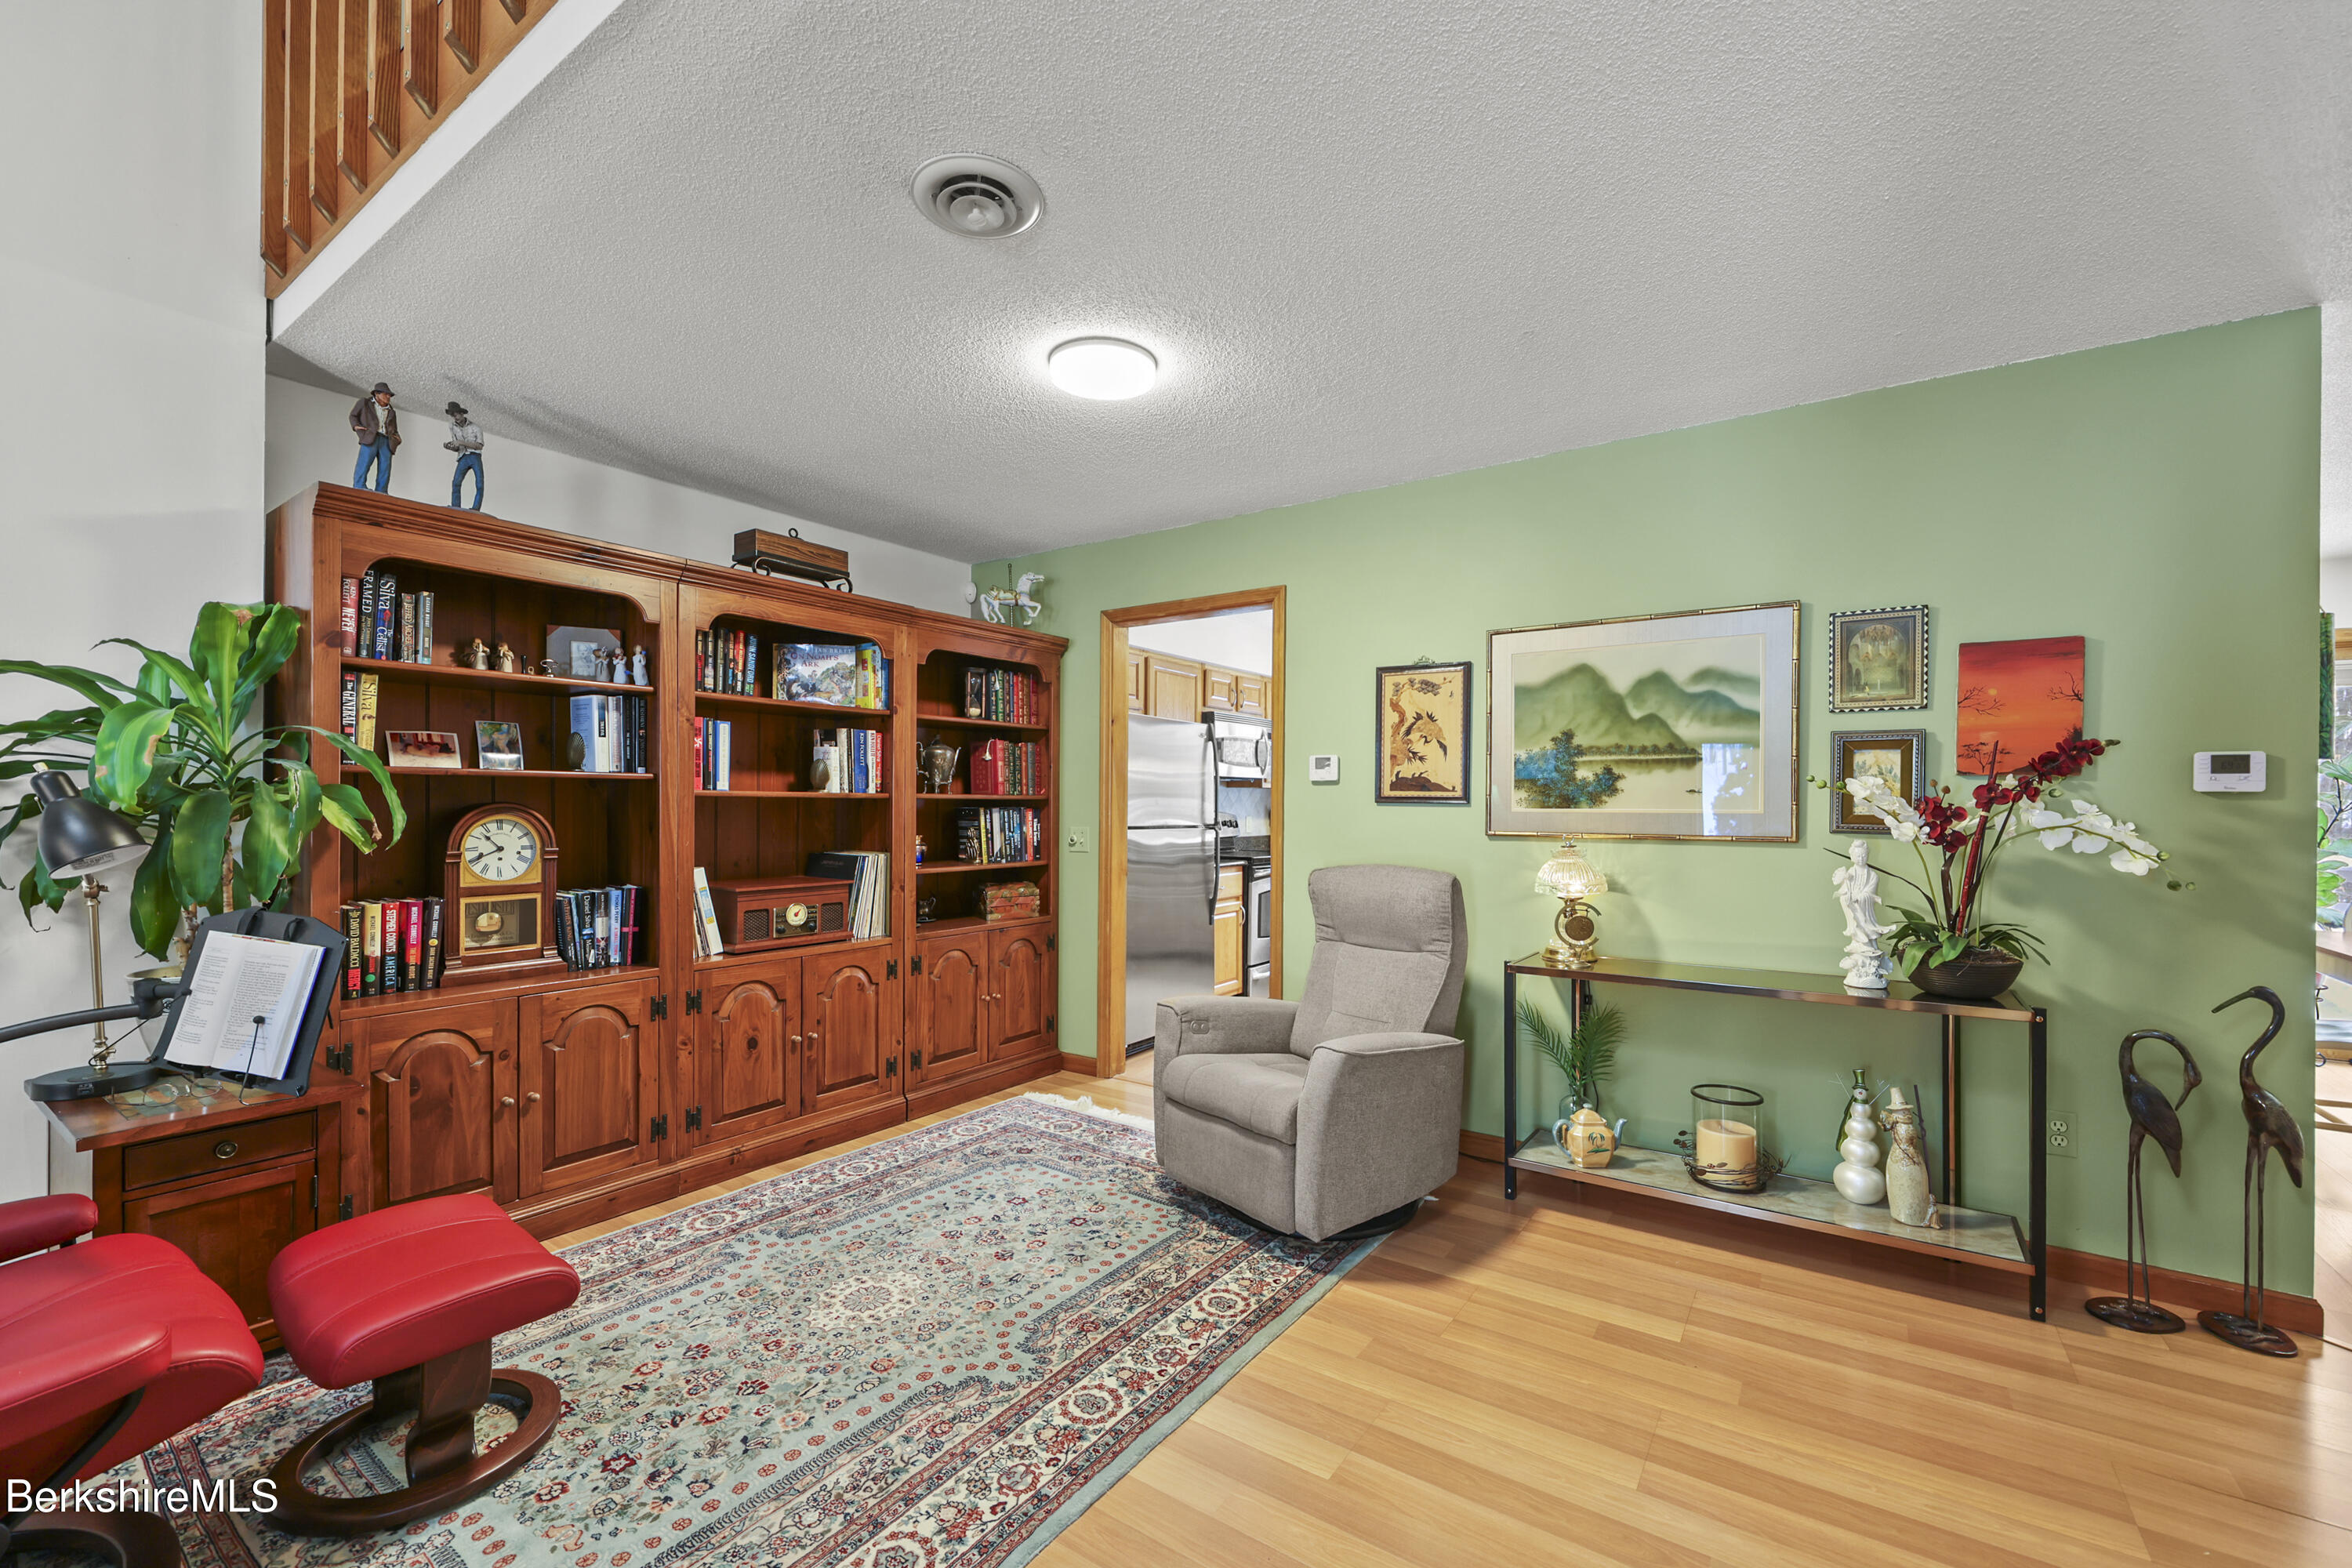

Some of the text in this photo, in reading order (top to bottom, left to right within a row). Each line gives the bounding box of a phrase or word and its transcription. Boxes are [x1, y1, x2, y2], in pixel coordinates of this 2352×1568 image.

[361, 570, 374, 613] FRAMED
[379, 580, 396, 609] Silva
[341, 607, 356, 633] NEVER
[404, 603, 414, 644] JEFFREY ARCHER
[376, 626, 388, 652] Cellist
[746, 636, 757, 683] JOHN SANDFORD
[342, 691, 356, 724] GENERAL
[361, 681, 377, 710] Silva
[432, 905, 441, 920] MICHAEL
[584, 915, 593, 928] Silva
[347, 918, 361, 990] DAVID BALDACCI MERCY
[385, 909, 396, 985] STEPHEN COONTS AMERICA
